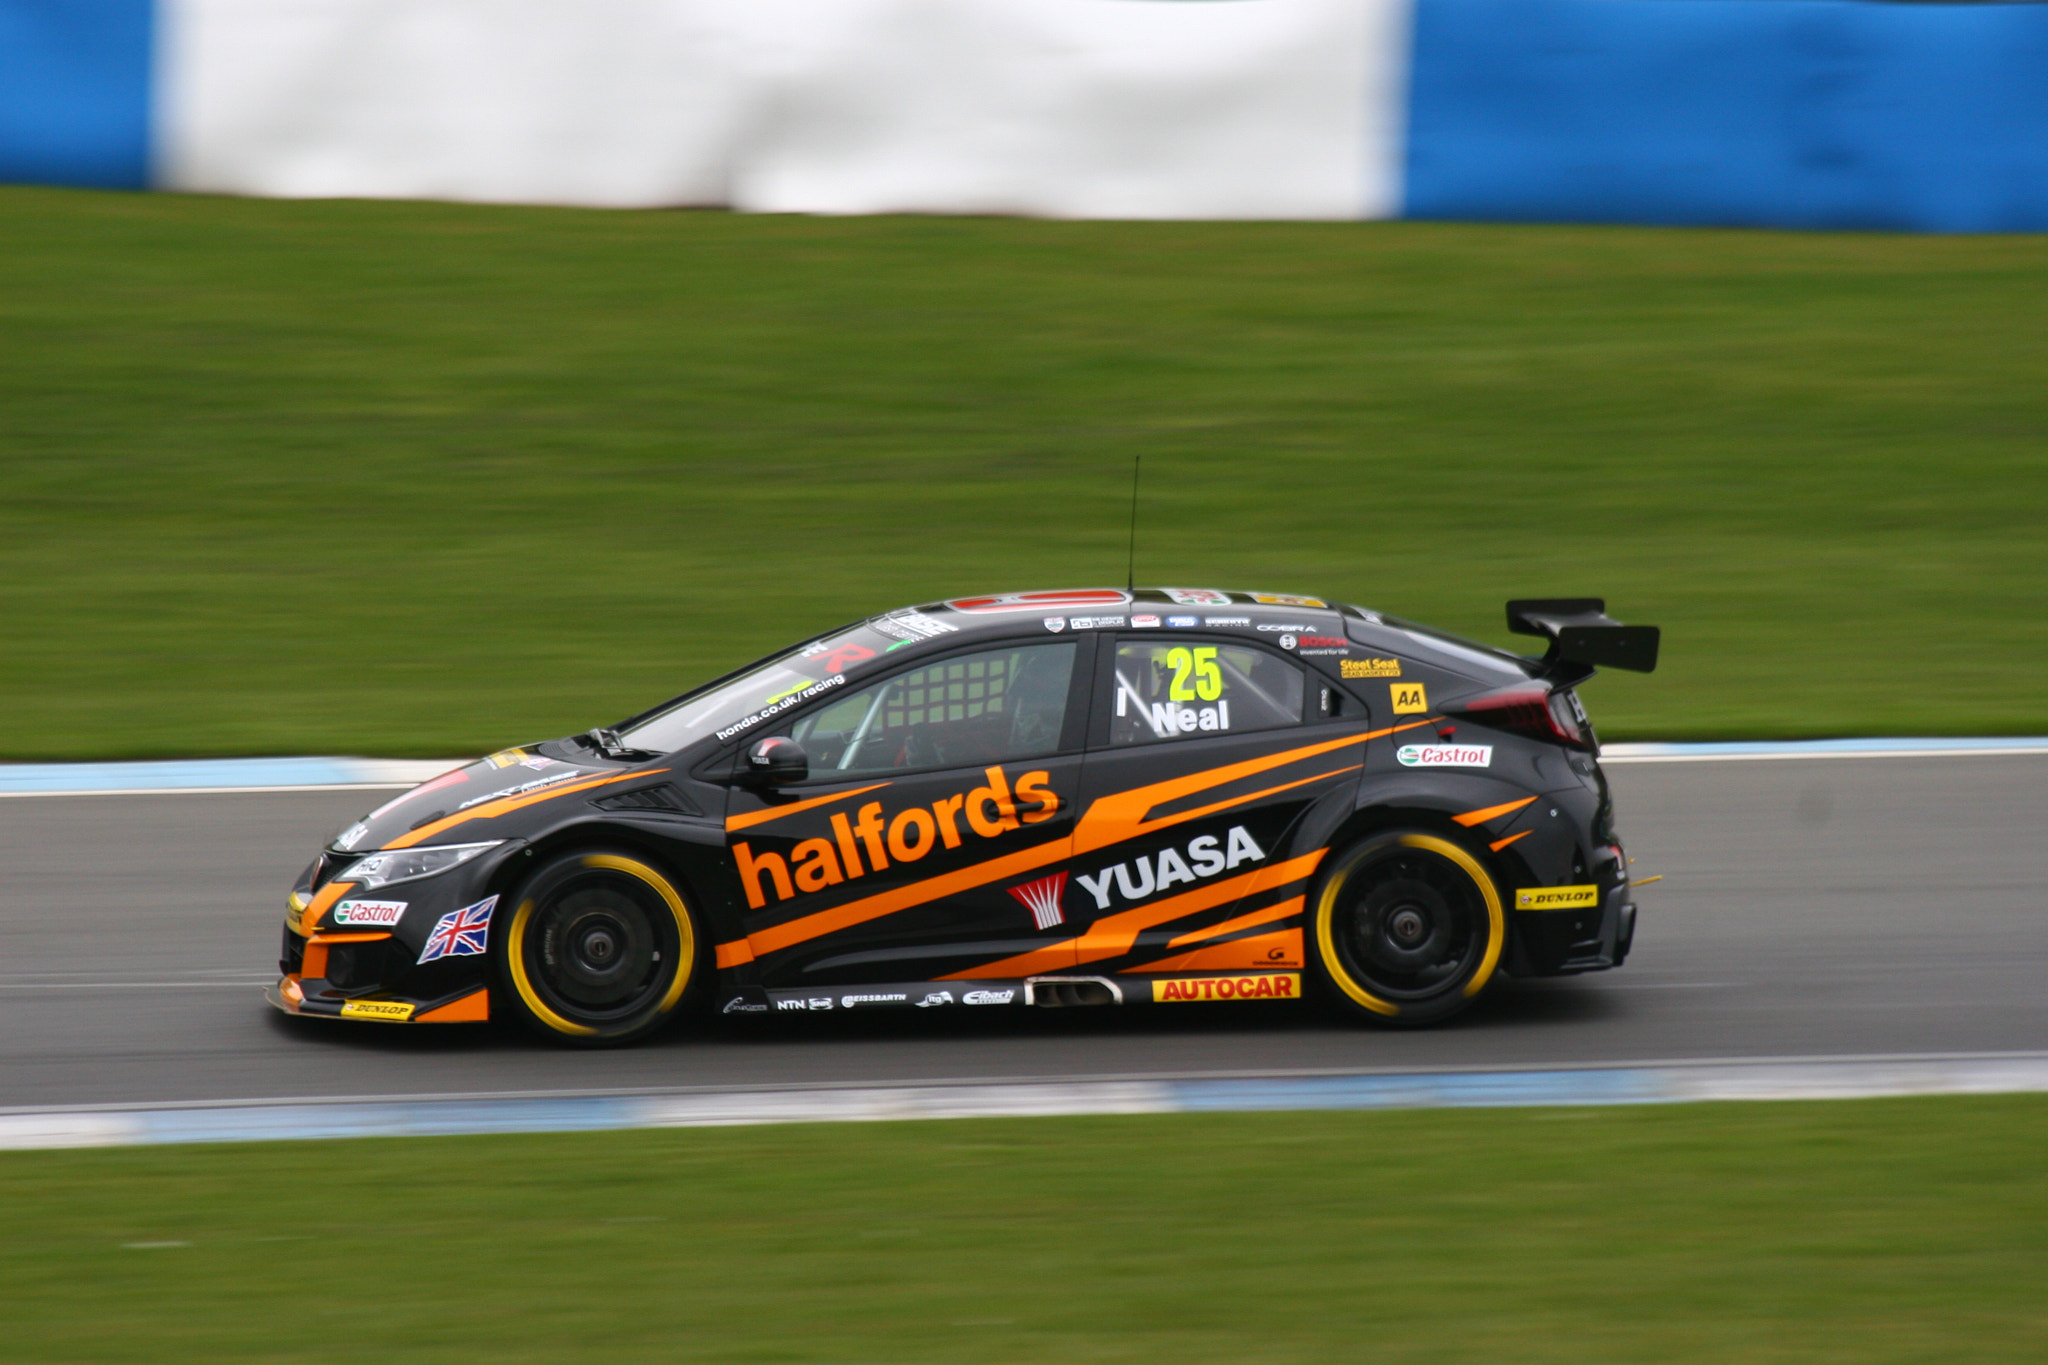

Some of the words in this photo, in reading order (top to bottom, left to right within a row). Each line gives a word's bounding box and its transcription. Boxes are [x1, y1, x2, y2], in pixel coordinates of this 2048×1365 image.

[1256, 624, 1317, 632] COBRA
[1298, 636, 1348, 647] BOSCH
[1340, 659, 1371, 670] Steel
[1372, 658, 1399, 669] Seal
[1166, 647, 1222, 701] 25
[1397, 690, 1421, 706] AA
[716, 674, 846, 740] honda.co.uk/racing
[1152, 700, 1229, 733] Neal
[1421, 746, 1486, 764] Castrol
[732, 765, 1061, 910] halfords
[1076, 825, 1267, 909] YUASA
[1534, 892, 1594, 904] DUNLOP
[349, 903, 400, 922] Castrol
[963, 990, 1015, 1003] Eibach
[1162, 977, 1293, 1000] AUTOCAR
[355, 1004, 409, 1015] DUNLOP
[777, 1000, 807, 1010] NTN
